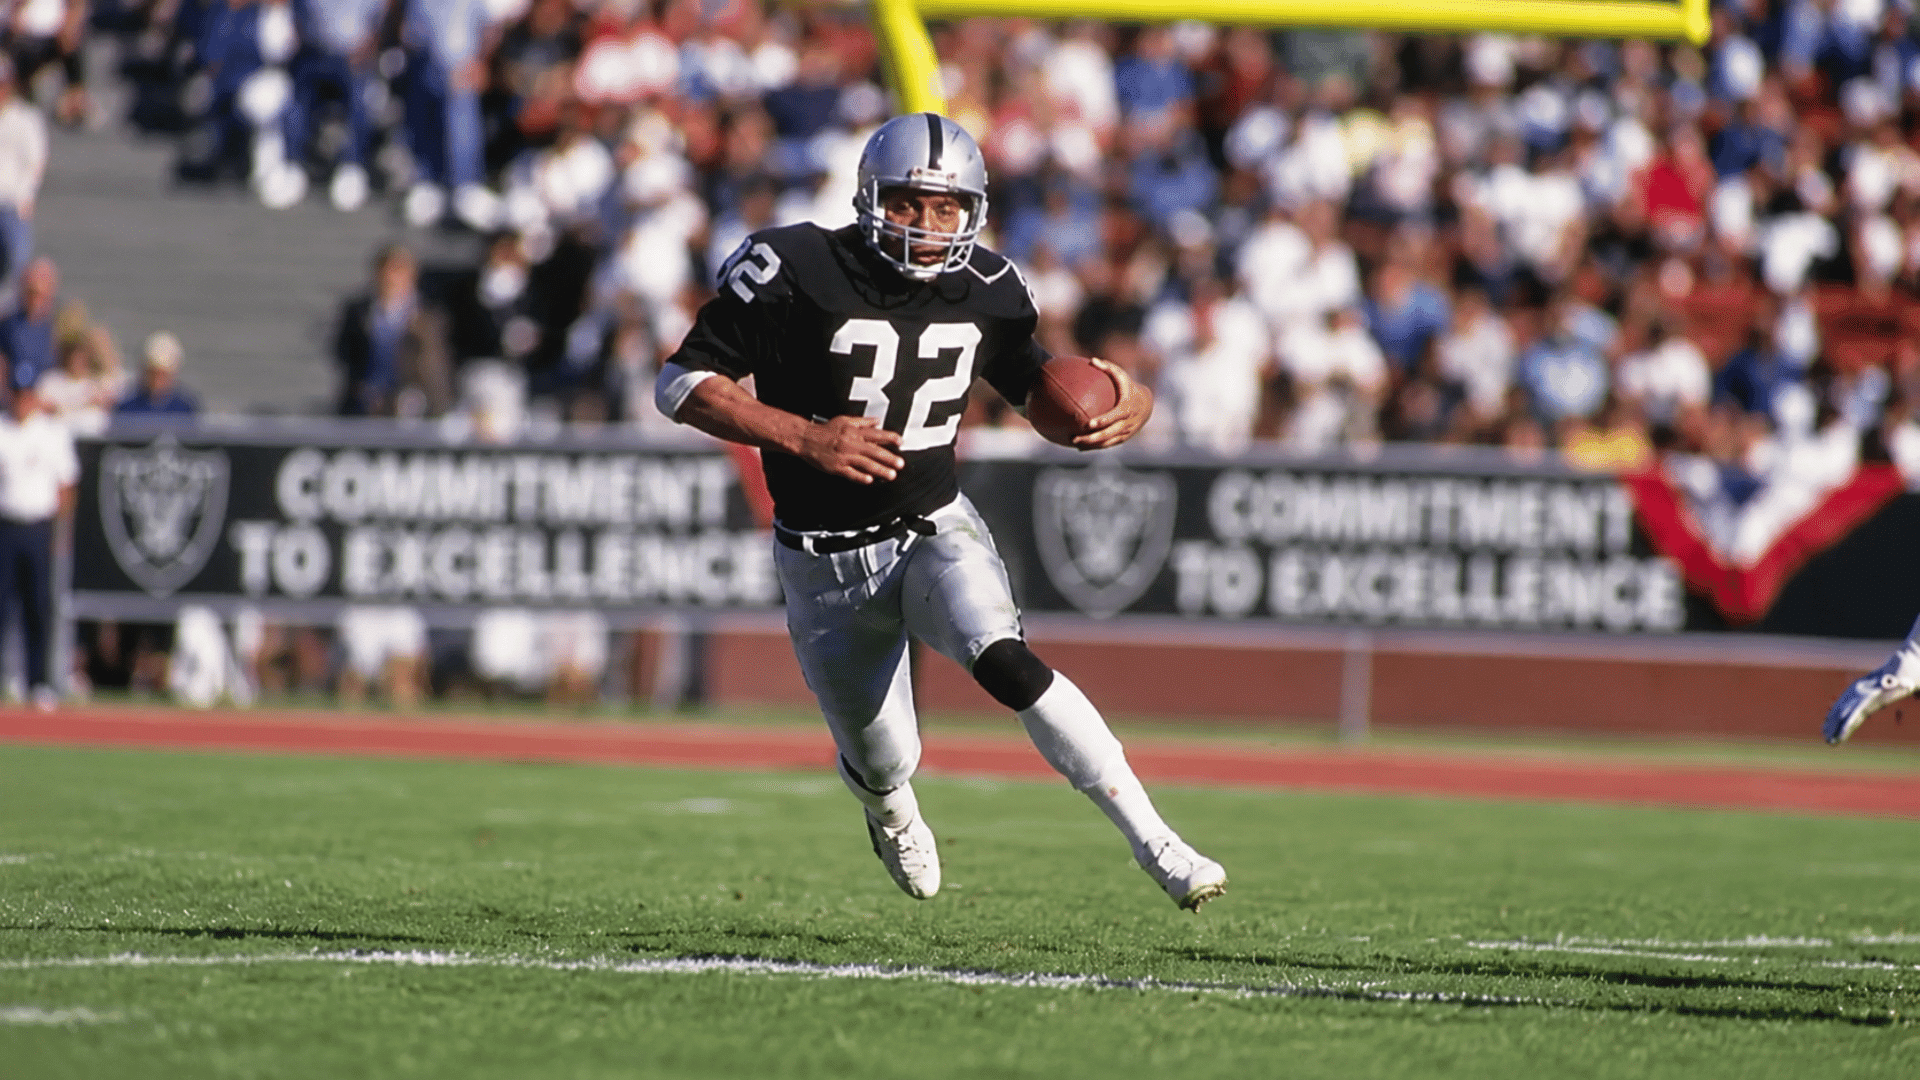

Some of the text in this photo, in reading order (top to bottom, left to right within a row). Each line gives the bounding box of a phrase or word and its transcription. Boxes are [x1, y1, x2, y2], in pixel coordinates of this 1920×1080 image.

[829, 318, 983, 451] 32
[277, 450, 736, 522] COMMITMENT
[1209, 472, 1635, 550] COMMITMENT
[231, 522, 778, 601] TO EXCELLENCE
[1172, 541, 1686, 630] TO EXCELLENCE
